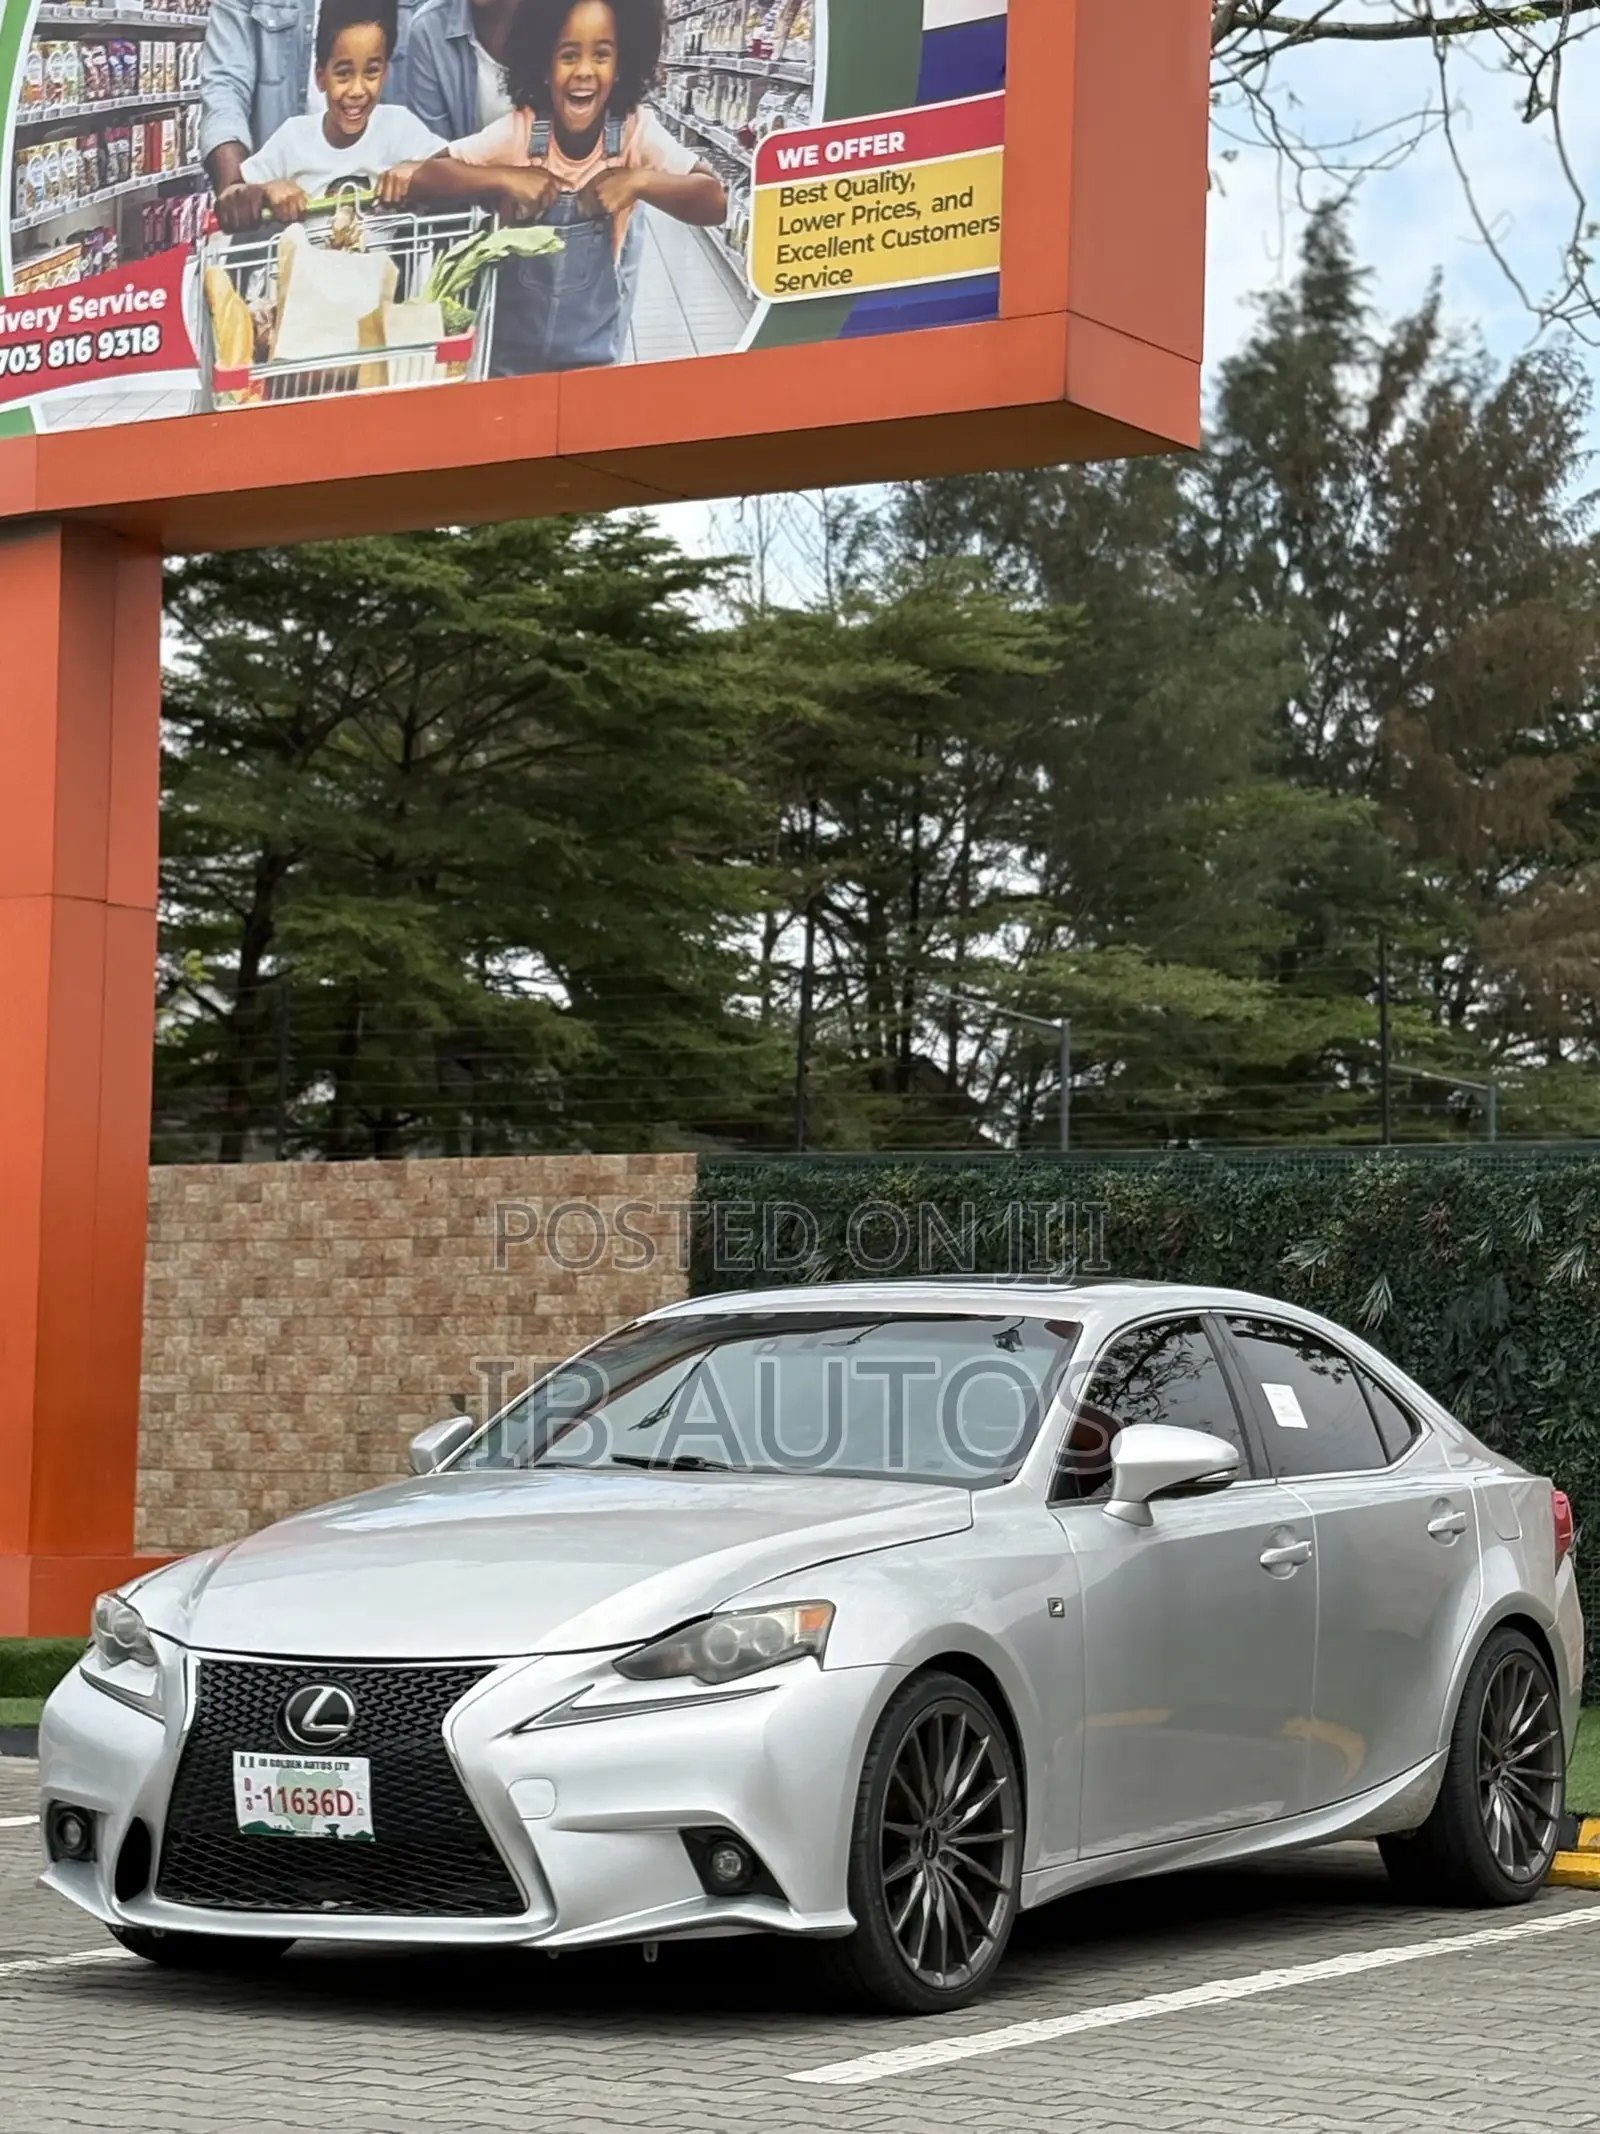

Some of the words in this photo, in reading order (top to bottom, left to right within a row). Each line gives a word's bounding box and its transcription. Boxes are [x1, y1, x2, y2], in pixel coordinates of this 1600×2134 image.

[776, 145, 819, 170] WE
[824, 131, 905, 163] OFFER
[779, 183, 828, 208] Best
[834, 171, 916, 200] Quality,
[778, 209, 845, 236] Lower
[851, 199, 922, 226] Prices,
[931, 186, 974, 212] and
[776, 232, 875, 265] Excellent
[881, 214, 1001, 250] Customers
[774, 264, 853, 293] Service
[68, 284, 167, 322] Service
[47, 333, 92, 368] 816
[97, 322, 161, 361] 9318
